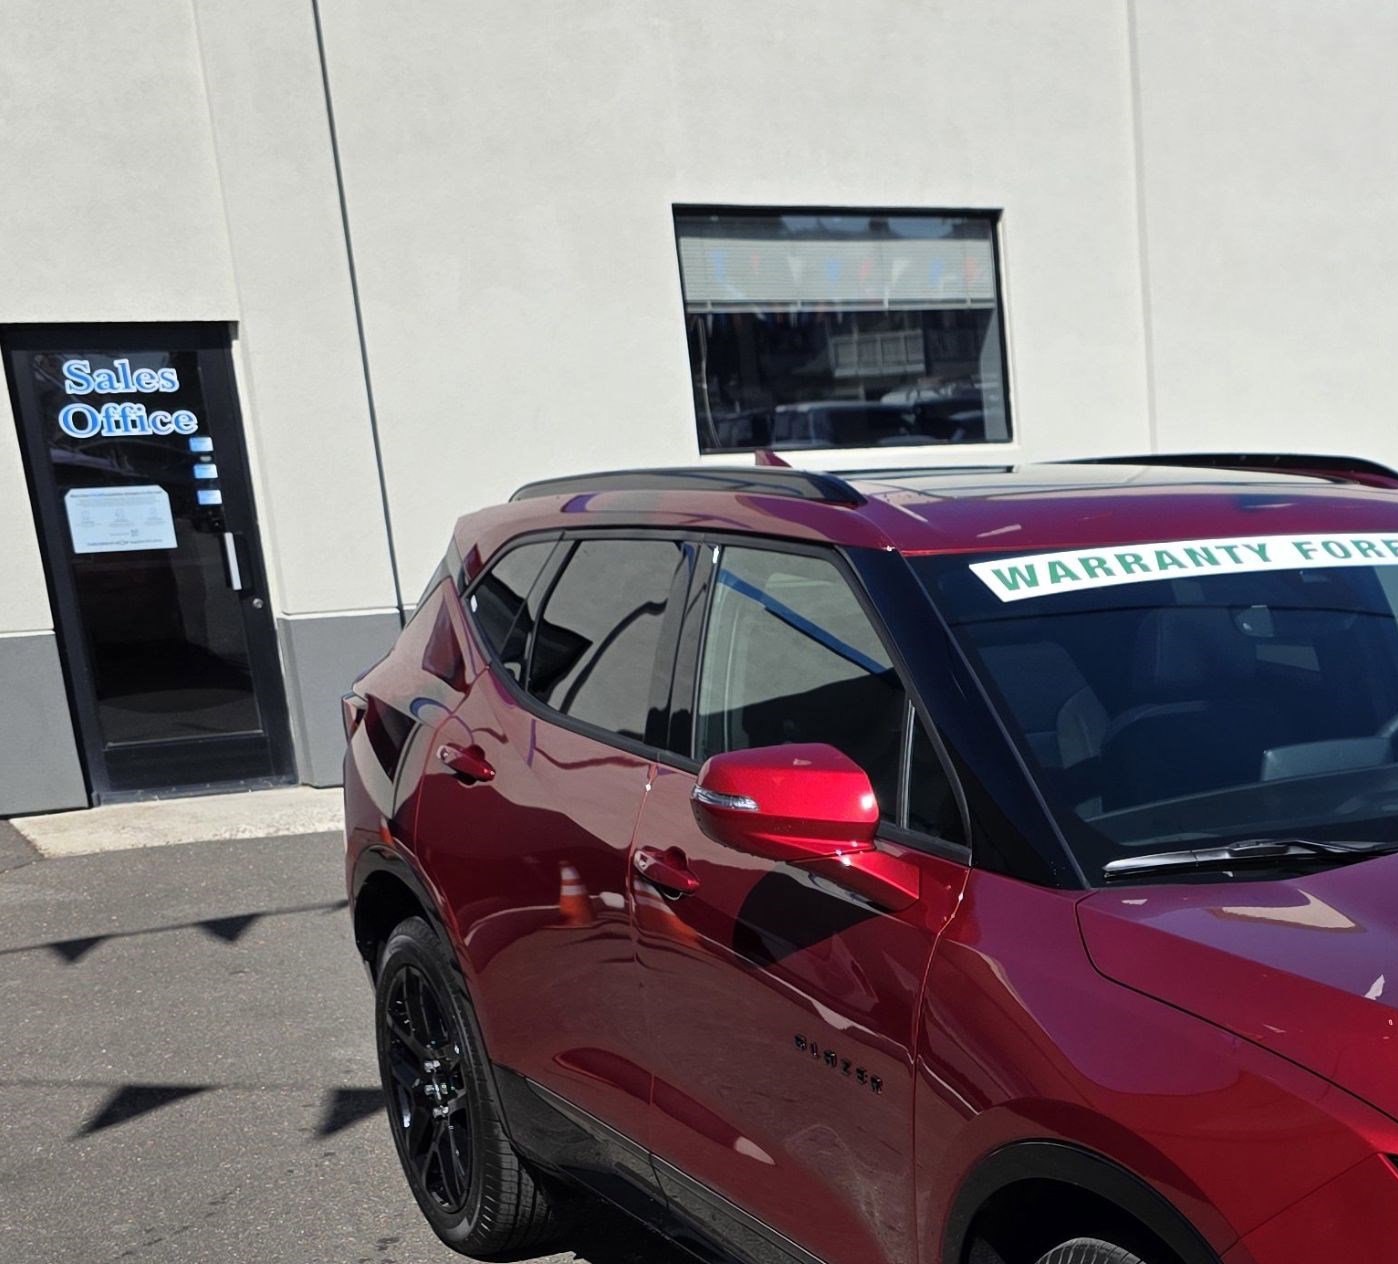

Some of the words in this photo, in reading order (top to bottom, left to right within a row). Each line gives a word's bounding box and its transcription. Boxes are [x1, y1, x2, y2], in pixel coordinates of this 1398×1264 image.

[63, 358, 180, 395] Sales
[58, 403, 199, 438] Office
[992, 540, 1272, 592] WARRANTY
